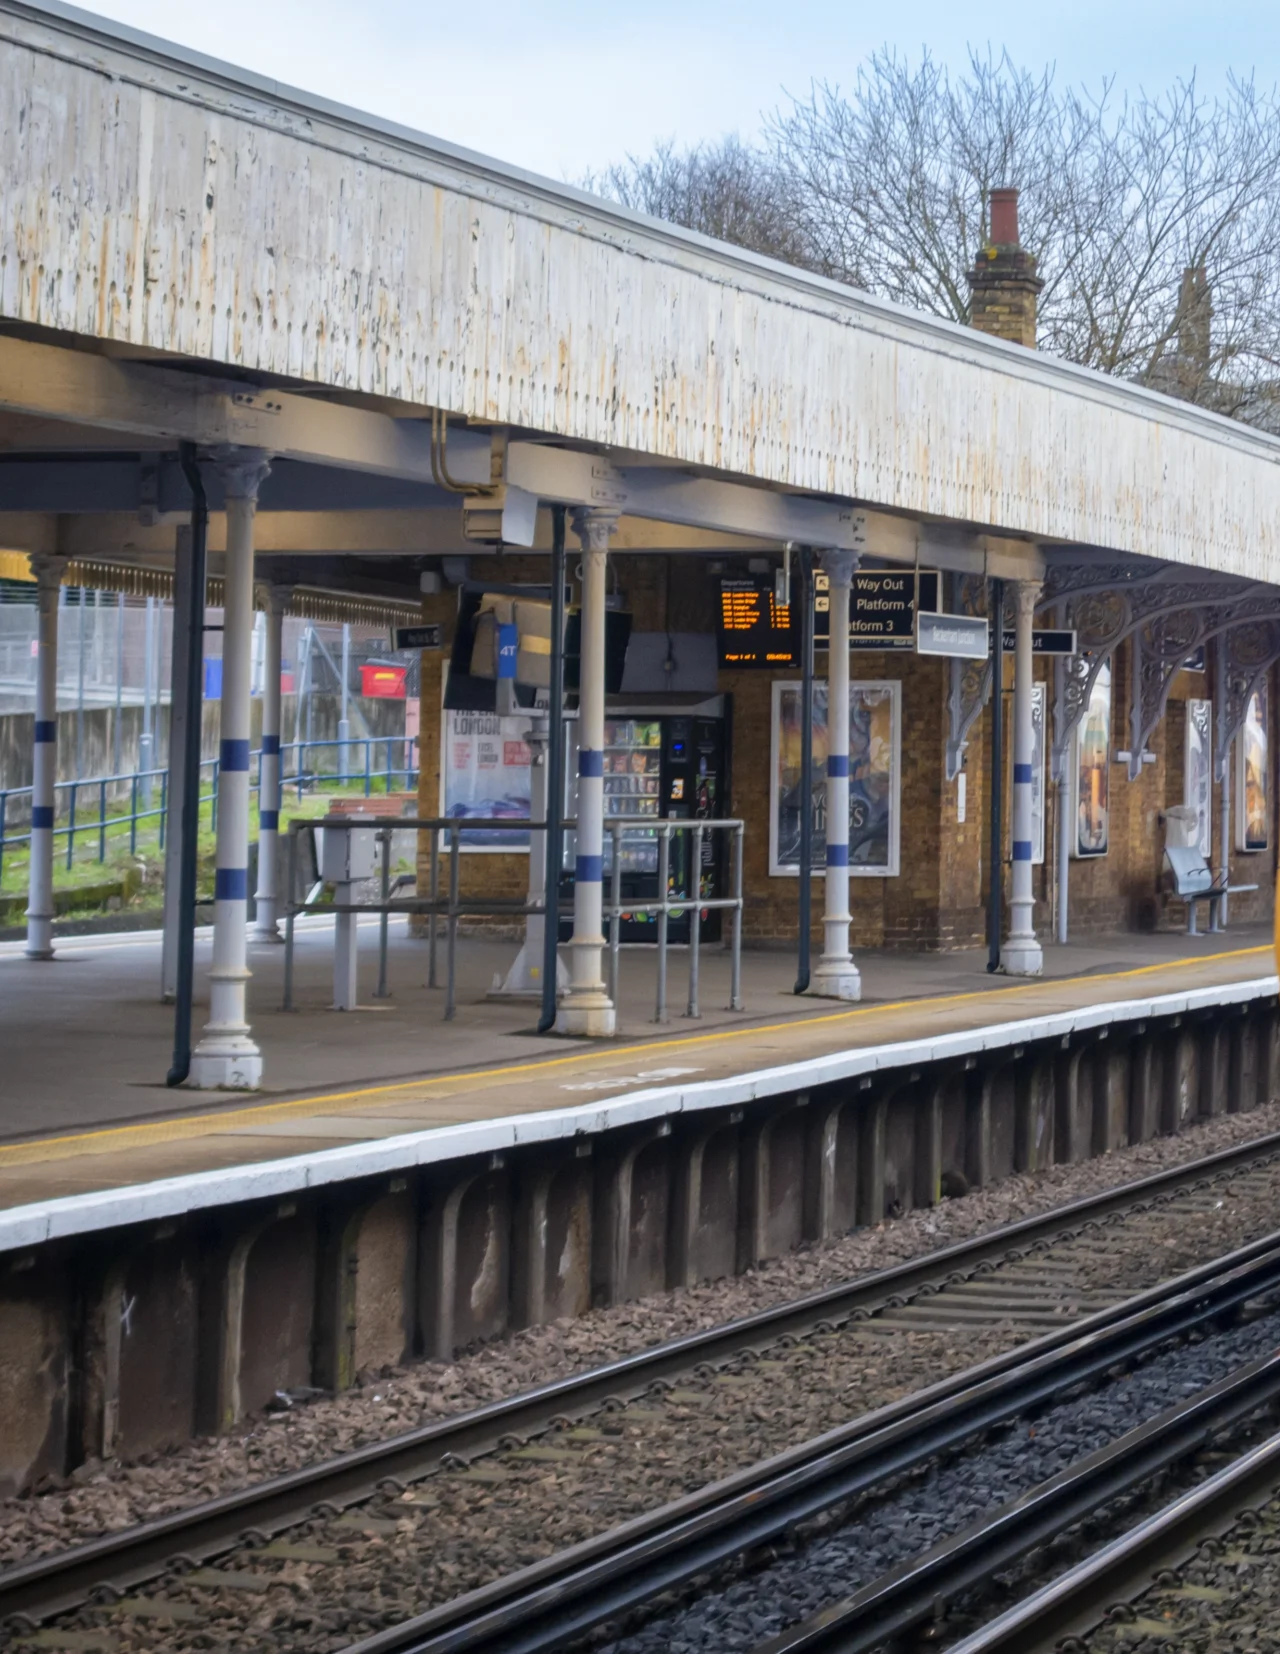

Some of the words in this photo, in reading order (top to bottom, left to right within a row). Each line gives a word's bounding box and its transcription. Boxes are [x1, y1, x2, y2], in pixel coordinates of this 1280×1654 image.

[857, 579, 880, 592] Way
[883, 579, 904, 590] Out
[856, 599, 905, 611] Platform
[907, 600, 914, 611] 4
[886, 620, 894, 632] 3
[500, 645, 516, 656] 4T
[453, 717, 500, 736] LONDON
